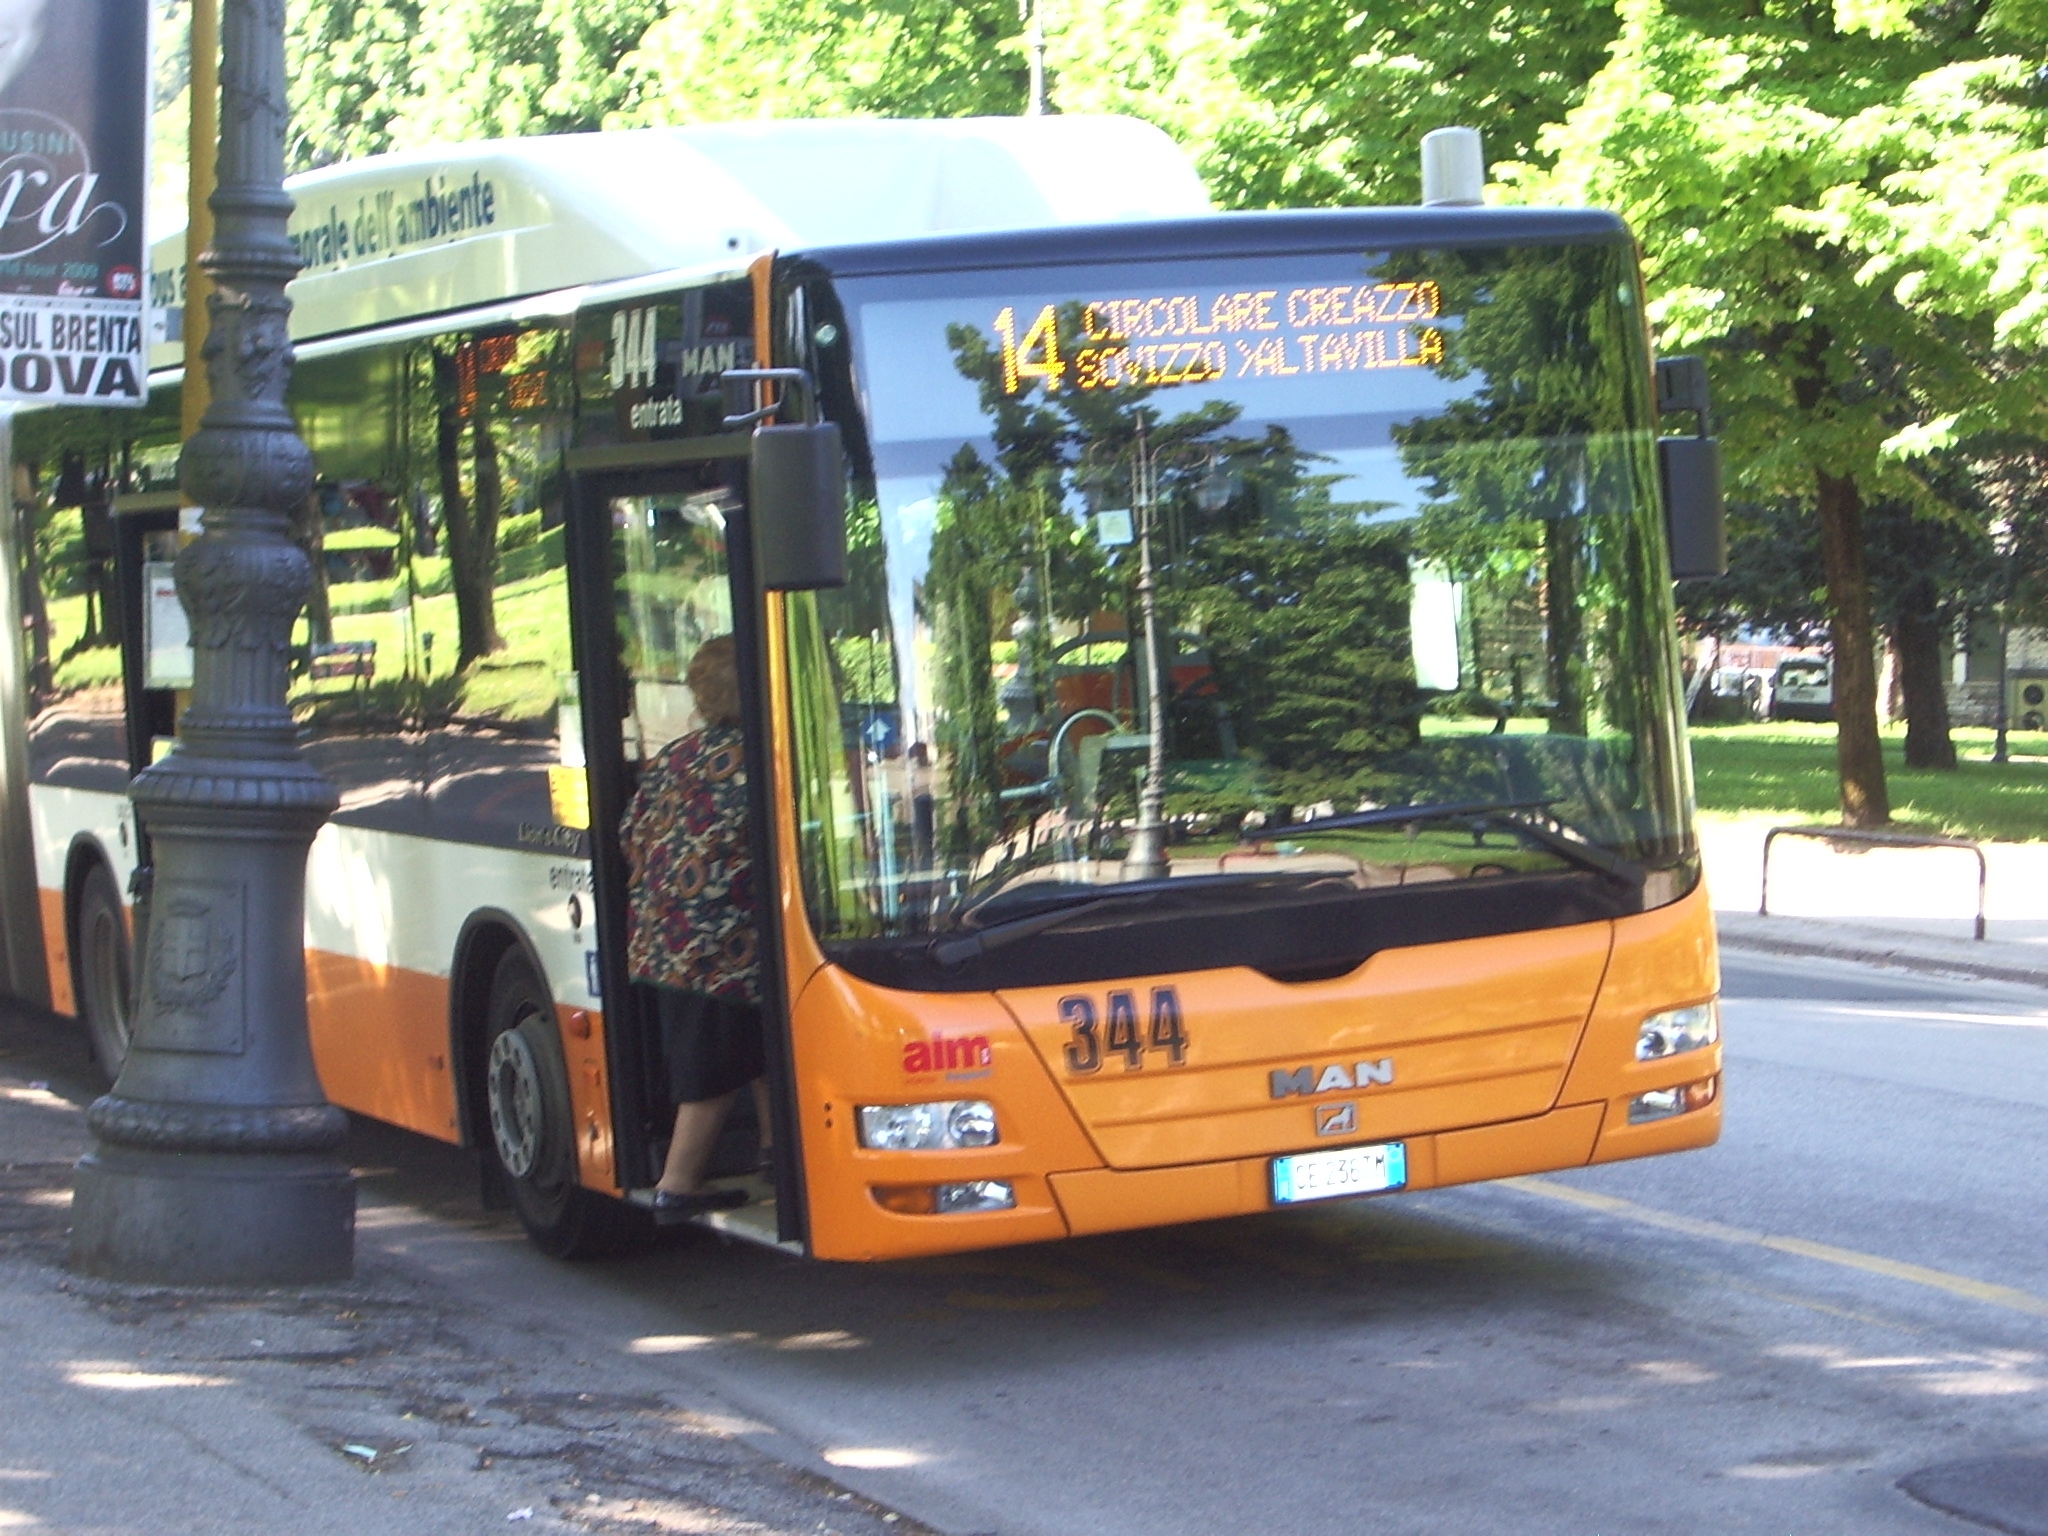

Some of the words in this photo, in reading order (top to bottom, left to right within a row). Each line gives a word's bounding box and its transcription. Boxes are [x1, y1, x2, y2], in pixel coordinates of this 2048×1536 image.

[0, 311, 42, 350] SUL
[51, 313, 142, 355] BRENTA
[609, 304, 658, 389] 344
[993, 304, 1066, 394] 14
[1084, 289, 1280, 341] CIRCOLARE
[1286, 280, 1441, 328] CREAZZO
[0, 353, 141, 397] OVA
[682, 341, 736, 378] MAN
[1075, 340, 1227, 390] SOVIZZO
[630, 394, 683, 430] entrata
[1060, 985, 1188, 1075] 344
[1269, 1056, 1393, 1099] MAN
